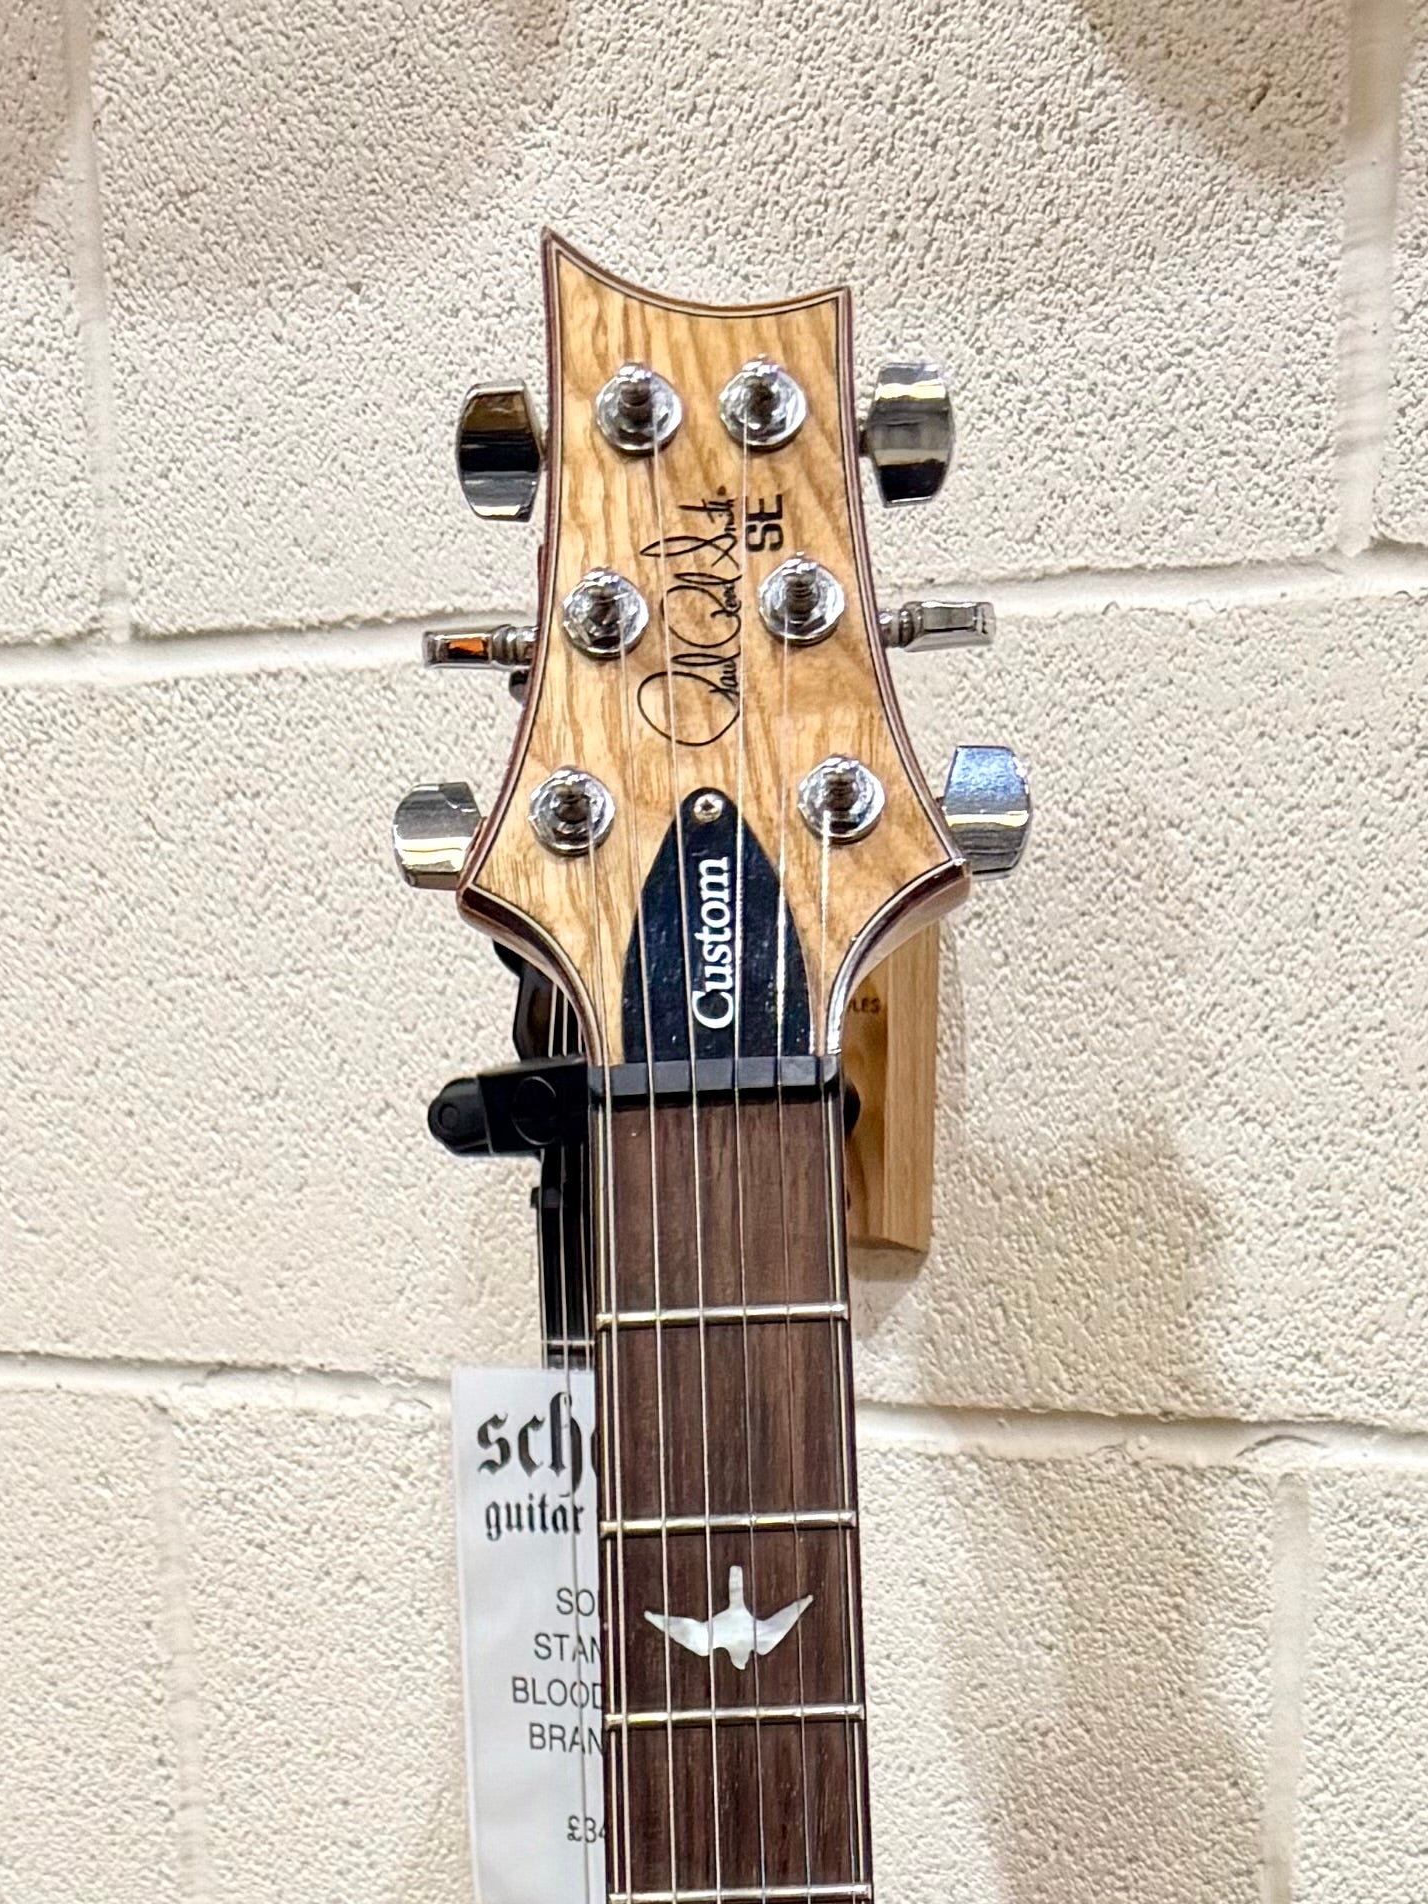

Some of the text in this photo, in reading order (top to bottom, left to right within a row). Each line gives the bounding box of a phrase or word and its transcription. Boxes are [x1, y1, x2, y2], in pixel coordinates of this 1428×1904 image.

[745, 494, 784, 553] SE
[691, 856, 735, 1029] Custom
[485, 1493, 584, 1541] guitar
